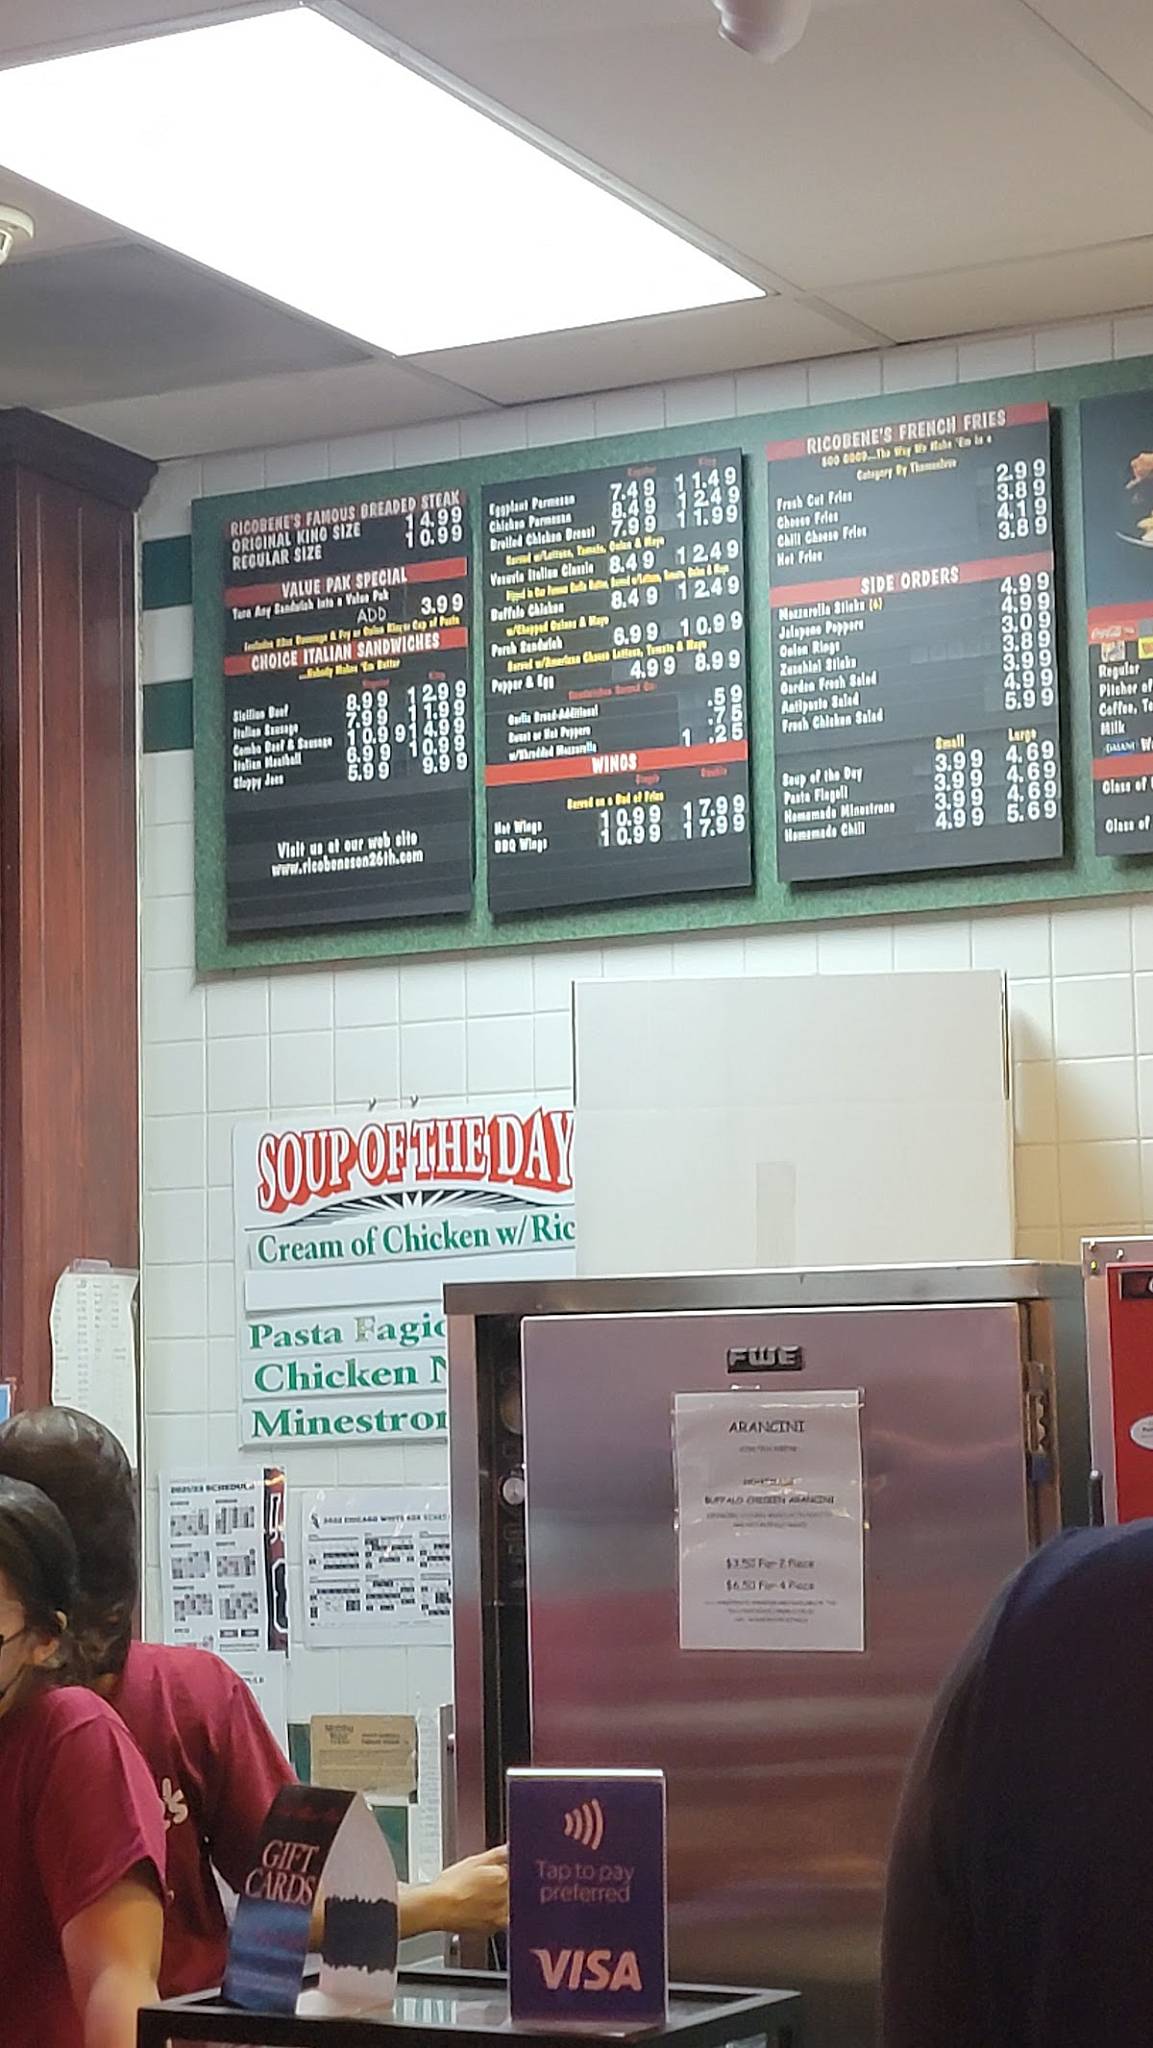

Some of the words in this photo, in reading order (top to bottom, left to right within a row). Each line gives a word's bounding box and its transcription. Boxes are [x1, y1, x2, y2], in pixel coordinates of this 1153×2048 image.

[807, 427, 892, 454] RICOBENE'S
[900, 416, 956, 440] FRENCH
[964, 410, 1006, 430] FRIES
[777, 496, 803, 511] Fresh
[807, 494, 824, 506] Cut
[829, 490, 852, 504] Fries
[996, 459, 1045, 482] 2.99
[307, 507, 355, 526] FAMOUS
[422, 490, 461, 509] STEAK
[777, 516, 810, 530] Cheese
[815, 511, 839, 524] Fries
[997, 479, 1046, 501] 3.89
[777, 534, 801, 548] Chili
[805, 530, 839, 544] Cheese
[843, 527, 867, 539] Fries
[997, 498, 1047, 520] 4.19
[232, 532, 291, 553] ORIGINAL
[297, 527, 327, 545] KING
[333, 523, 361, 539] SIZE
[406, 506, 462, 530] 14.99
[232, 550, 289, 570] REGULAR
[294, 545, 322, 561] SIZE
[406, 524, 462, 548] 10.99
[777, 552, 794, 566] Hot
[799, 550, 823, 564] Fries
[998, 517, 1047, 540] 3.89
[282, 579, 320, 598] VALUE
[326, 573, 350, 592] PAK
[356, 567, 407, 589] SPECIAL
[779, 603, 831, 621] Mozzarella
[834, 601, 865, 614] Sticks
[1000, 572, 1049, 596] 4.99
[861, 575, 894, 594] SIDE
[901, 567, 959, 590] ORDERS
[357, 607, 387, 624] ADD
[421, 593, 463, 615] 3.99
[252, 651, 297, 670] CHOICE
[303, 642, 351, 663] ITALIAN
[357, 633, 439, 658] SANDWICHES
[780, 681, 816, 696] Garden
[819, 675, 846, 690] Fresh
[850, 671, 877, 688] Salad
[1003, 649, 1051, 672] 3.99
[1099, 663, 1140, 680] Regular
[1099, 680, 1137, 698] Pitcher
[233, 726, 261, 740] Italian
[264, 723, 299, 736] Sausage
[346, 708, 388, 729] 7.99
[409, 700, 465, 721] 11.99
[782, 717, 809, 732] Fresh
[813, 713, 852, 729] Chicken
[856, 708, 884, 725] Salad
[1005, 688, 1054, 711] 5.99
[1099, 701, 1137, 717] Coffee,
[935, 734, 965, 750] Small
[1008, 728, 1037, 743] Large
[1100, 719, 1126, 737] Milk
[233, 777, 261, 791] Sloppy
[265, 774, 284, 786] Joes
[348, 762, 390, 782] 5.99
[423, 752, 468, 774] 9.99
[234, 758, 262, 772] Italian
[265, 752, 301, 768] Meatball
[347, 744, 391, 764] 6.99
[409, 735, 465, 757] 10.99
[592, 753, 637, 774] WINGS
[782, 773, 806, 788] Soup
[810, 768, 821, 783] of
[824, 768, 839, 782] the
[843, 767, 862, 782] Day
[935, 750, 983, 773] 3.99
[1006, 741, 1054, 765] 4.69
[784, 810, 836, 824] Homemade
[841, 803, 894, 819] Minestrone
[935, 789, 983, 811] 3.99
[1007, 781, 1056, 803] 4.69
[1103, 778, 1131, 795] Glass
[1135, 777, 1147, 792] of
[494, 822, 511, 835] Hot
[514, 820, 542, 835] Wings
[601, 805, 661, 828] 10.99
[684, 795, 745, 819] 17.99
[784, 827, 837, 843] Homemade
[841, 822, 865, 836] Chili
[935, 808, 984, 831] 4.99
[1007, 801, 1056, 823] 5.69
[1106, 818, 1134, 834] Glass
[1138, 816, 1150, 831] of
[277, 841, 304, 858] Visit
[310, 843, 323, 855] us
[328, 839, 340, 853] at
[344, 838, 364, 853] our
[368, 831, 390, 849] web
[396, 830, 417, 847] site
[494, 839, 516, 854] BBQ
[520, 838, 548, 853] Wings
[601, 825, 661, 847] 10.99
[684, 814, 745, 839] 17.99
[257, 1125, 353, 1215] SOUP
[357, 1122, 409, 1187] OF
[408, 1116, 489, 1182] THE
[489, 1106, 574, 1193] DAY
[258, 1234, 343, 1263] Cream
[351, 1226, 377, 1256] of
[383, 1219, 490, 1252] Chicken
[496, 1215, 525, 1246] w/
[250, 1323, 342, 1349] Pasta
[729, 1346, 799, 1369] FWE
[254, 1361, 417, 1392] Chicken
[729, 1420, 805, 1433] ARANCINI
[262, 1840, 319, 1872] GIFT
[536, 1860, 573, 1881] Tap
[576, 1862, 596, 1879] to
[600, 1862, 635, 1884] pay
[245, 1868, 316, 1905] CARDS
[539, 1881, 631, 1904] preferred
[530, 1948, 642, 1992] VISA
